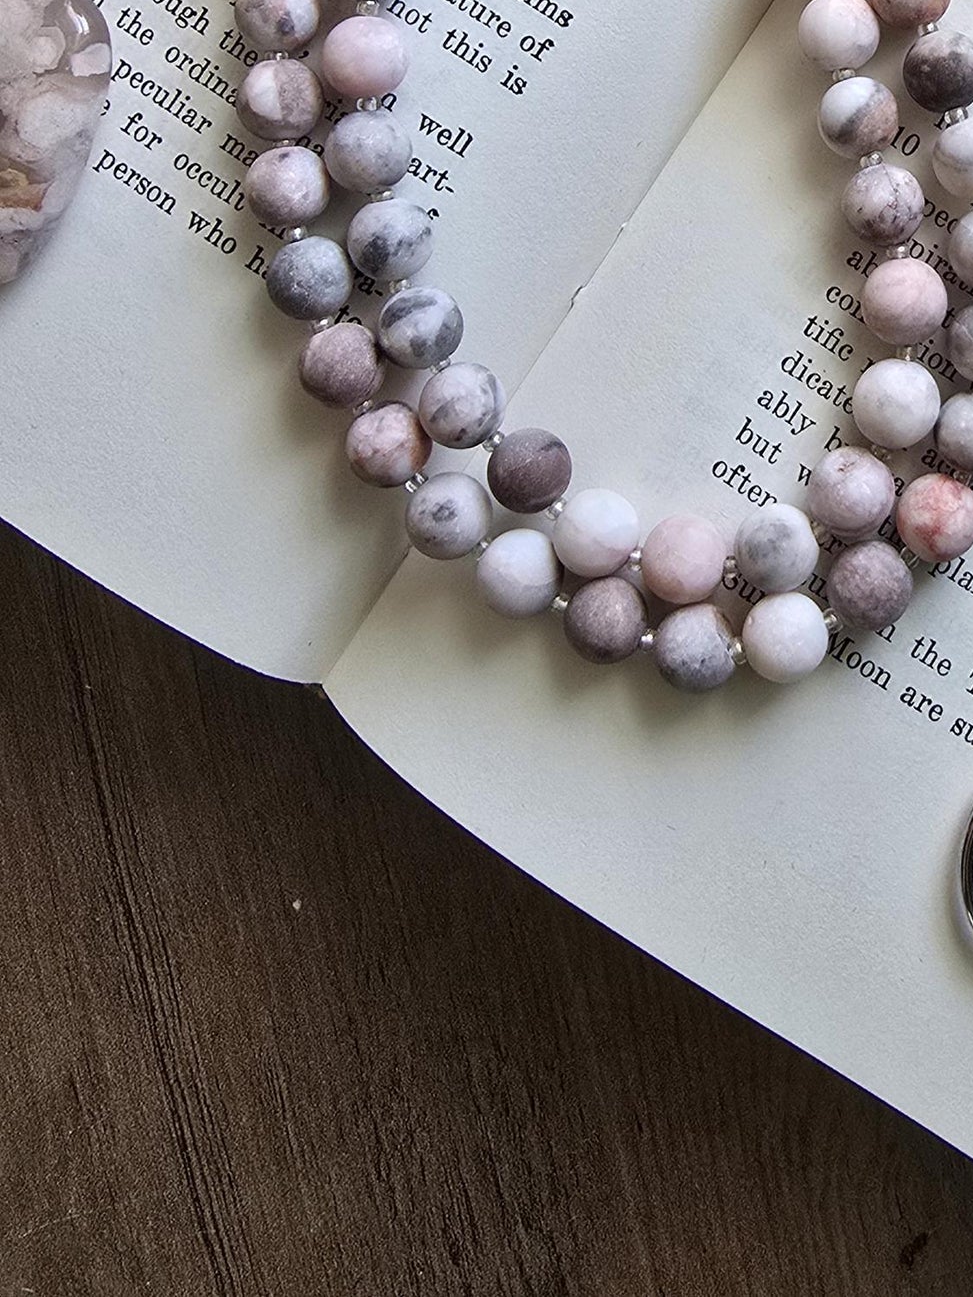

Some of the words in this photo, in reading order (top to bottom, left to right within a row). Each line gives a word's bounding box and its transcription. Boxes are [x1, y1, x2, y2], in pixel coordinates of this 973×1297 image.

[116, 7, 155, 46] the
[442, 28, 493, 74] this
[111, 59, 213, 135] peculiar
[119, 112, 163, 151] for
[418, 112, 474, 159] well
[93, 149, 177, 216] person
[187, 210, 238, 255] who
[756, 389, 817, 436] ably
[735, 416, 783, 465] but
[910, 636, 952, 677] the
[899, 686, 944, 723] are
